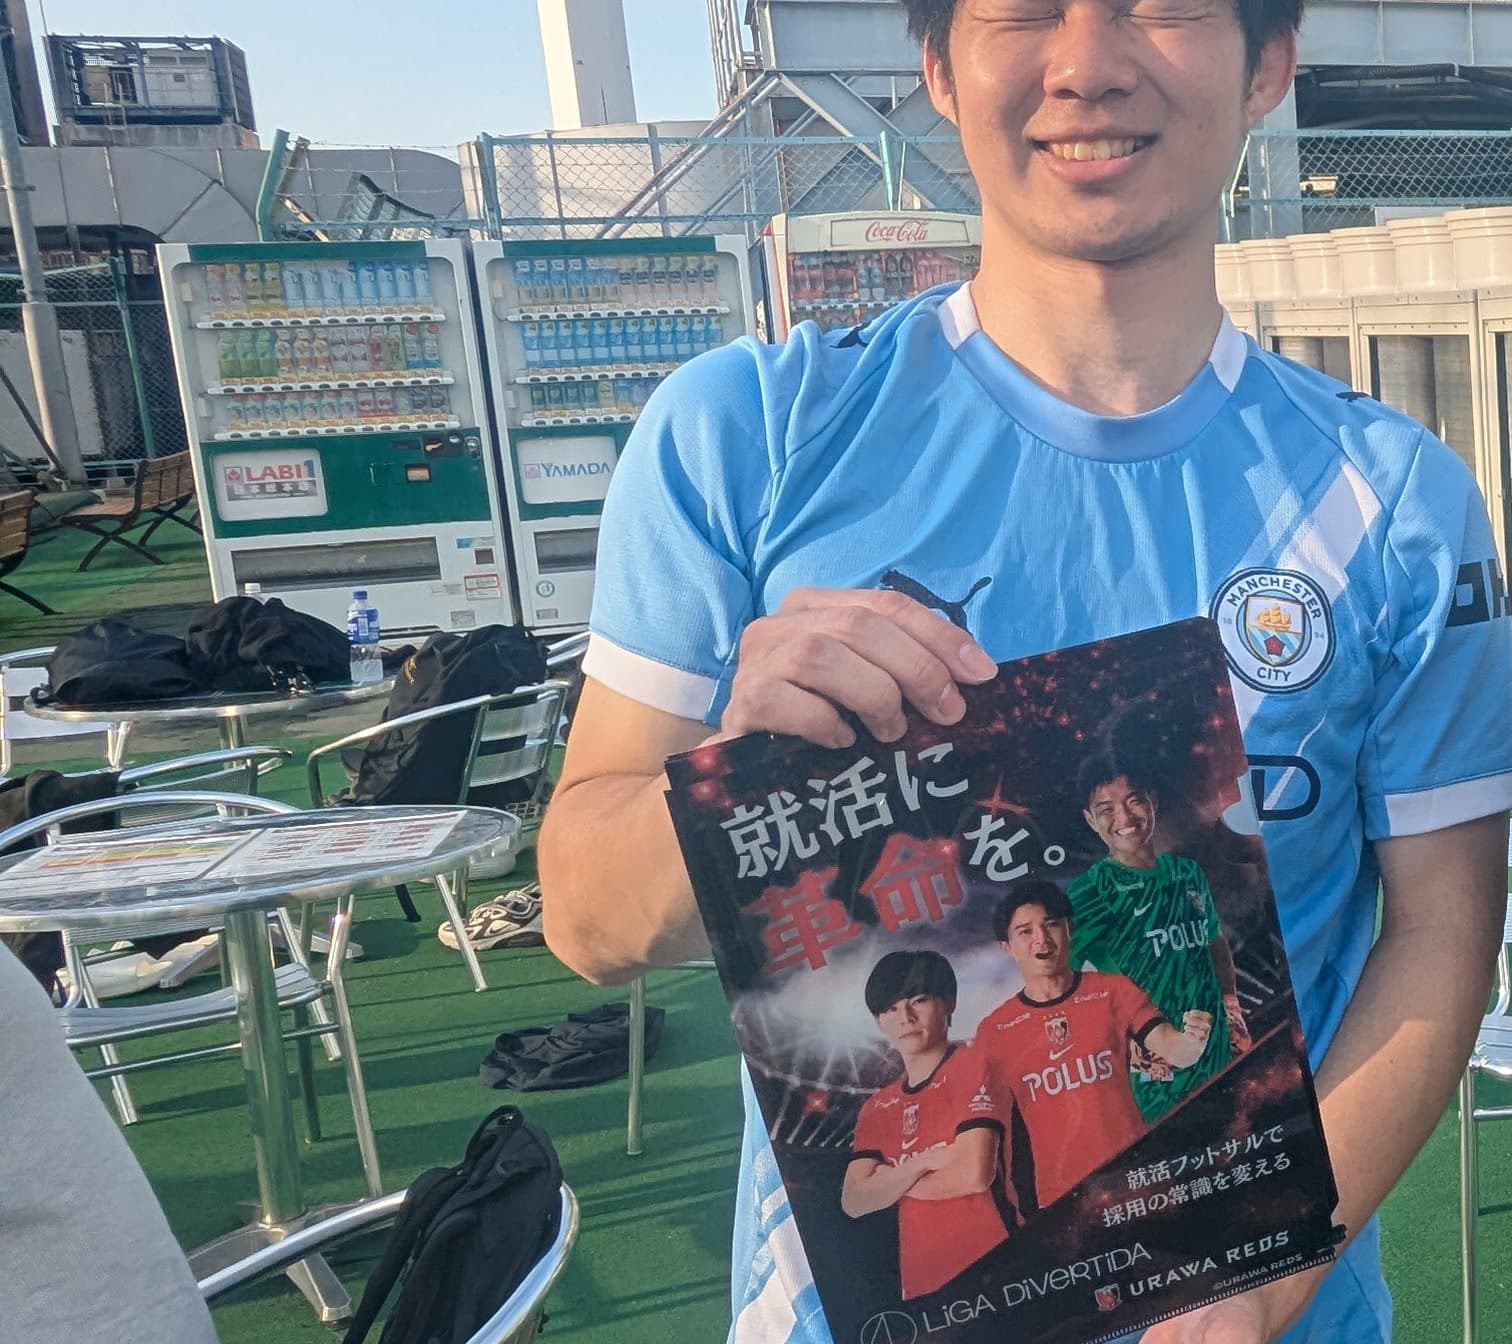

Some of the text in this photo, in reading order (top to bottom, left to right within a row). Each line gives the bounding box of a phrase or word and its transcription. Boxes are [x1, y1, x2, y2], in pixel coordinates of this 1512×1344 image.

[865, 220, 929, 242] Coca-Cola
[541, 462, 610, 477] YAMADA
[1227, 577, 1322, 619] MANCHESTER
[1256, 667, 1291, 682] CITY
[720, 742, 969, 879] 就活に
[1022, 1050, 1112, 1102] POLUS
[1126, 1124, 1285, 1190] 就活フットサルで
[1103, 1152, 1291, 1227] 採用の常識を変える
[1129, 1230, 1289, 1297] URAWA REDS
[1271, 1254, 1303, 1270] REDS
